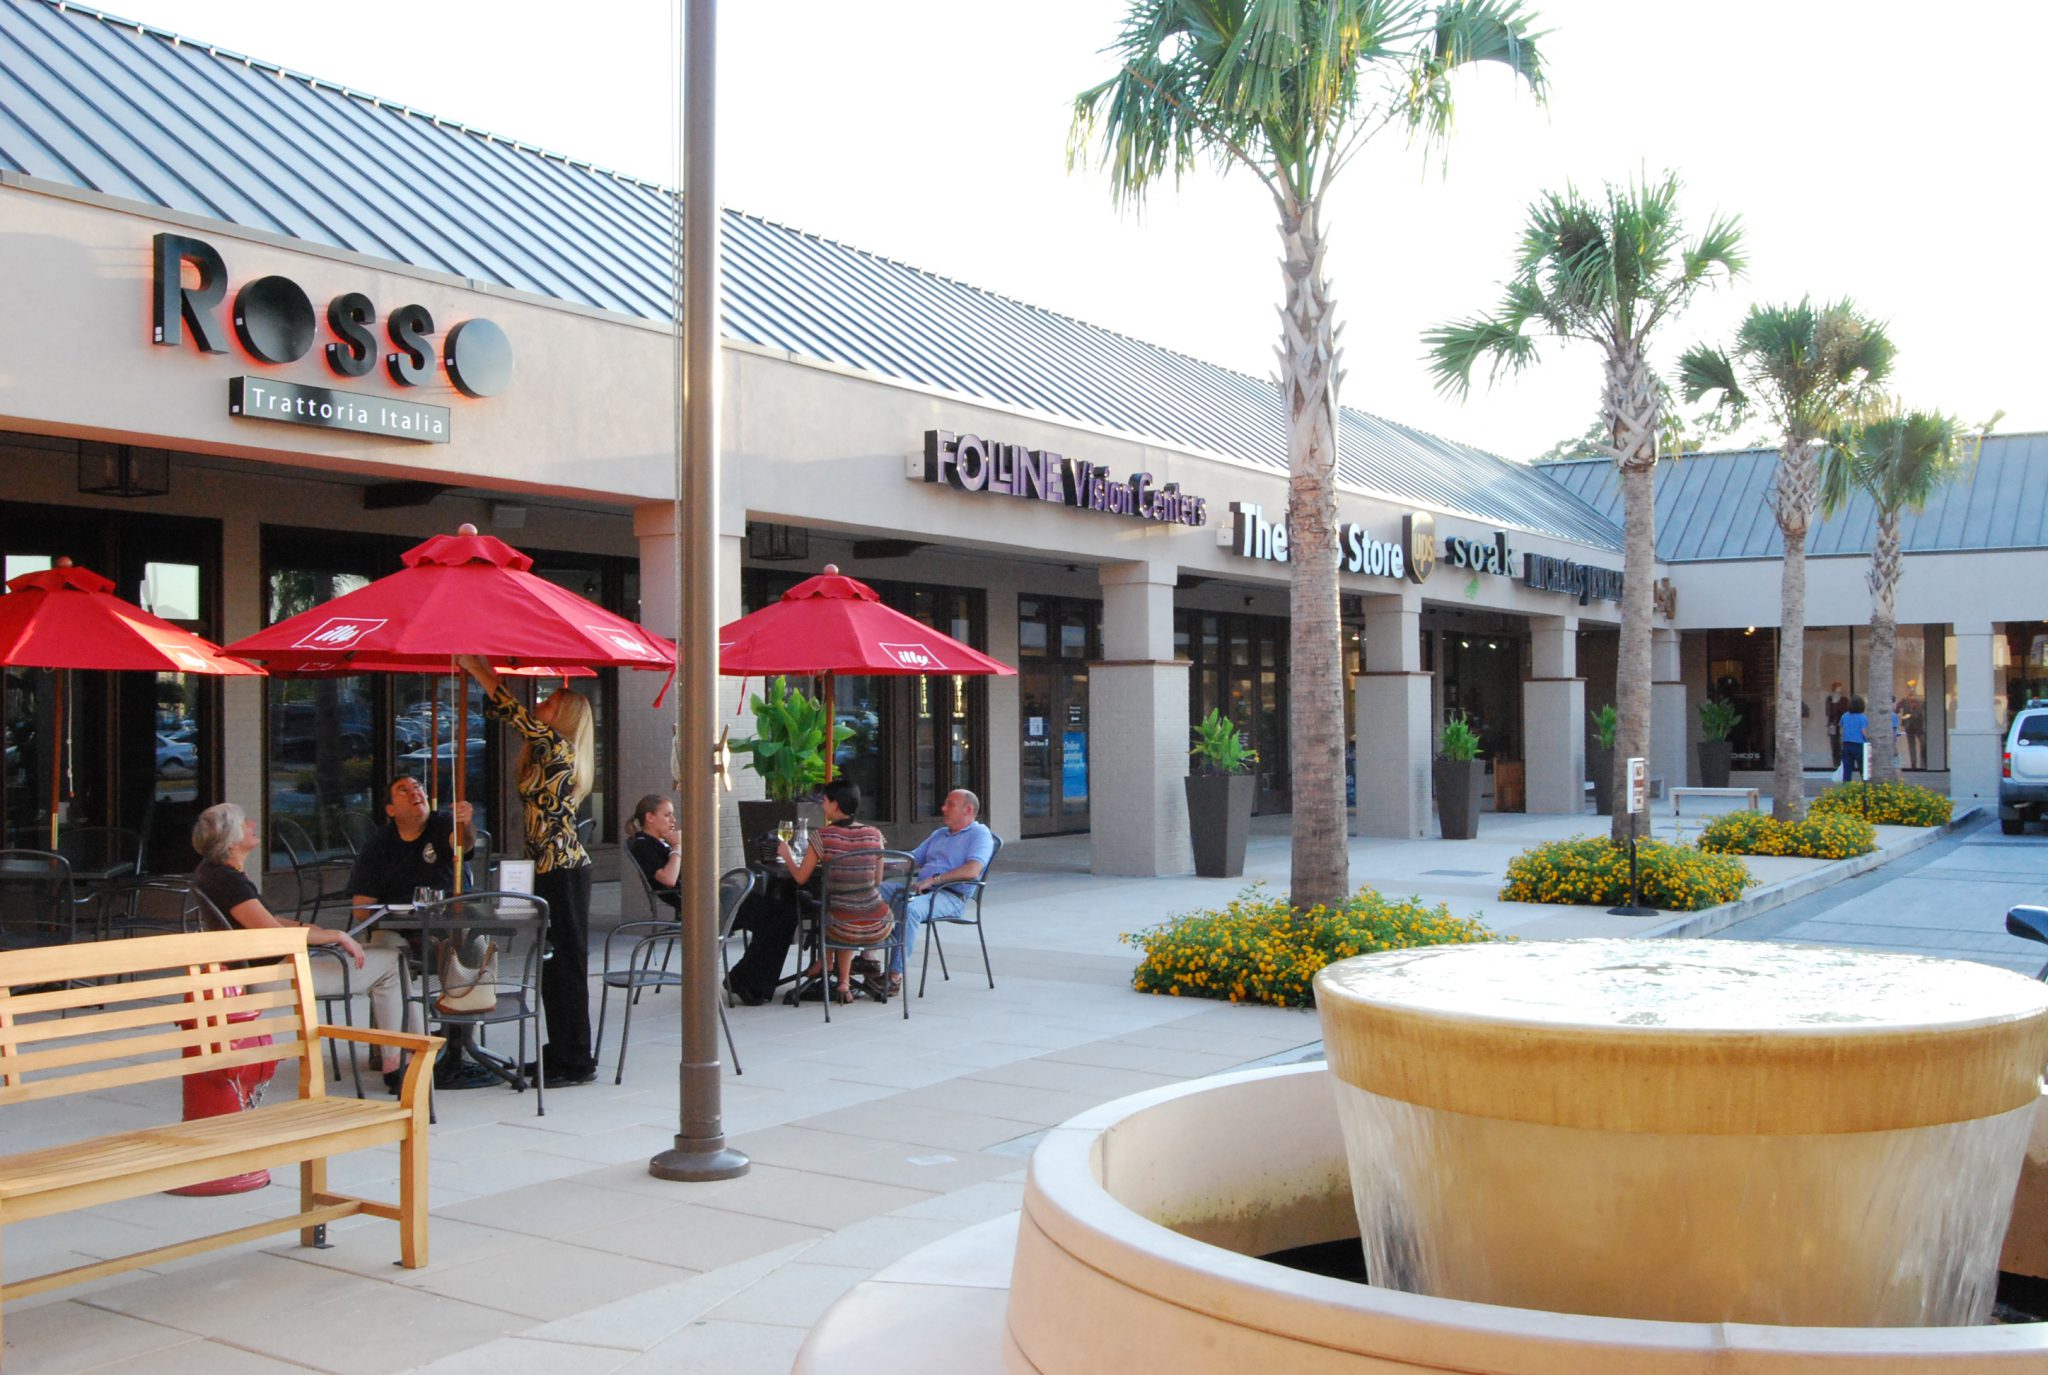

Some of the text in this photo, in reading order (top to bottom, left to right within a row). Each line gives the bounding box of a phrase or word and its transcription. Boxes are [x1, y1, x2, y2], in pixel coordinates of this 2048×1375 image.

[252, 388, 443, 434] Trattoria Italia
[1062, 457, 1135, 516] Vision
[1129, 472, 1207, 527] Centers
[1230, 501, 1288, 562] The
[1348, 522, 1404, 579] Store
[1412, 533, 1434, 572] ups
[1446, 529, 1516, 577] soak
[313, 624, 361, 646] illy
[897, 650, 930, 667] illy
